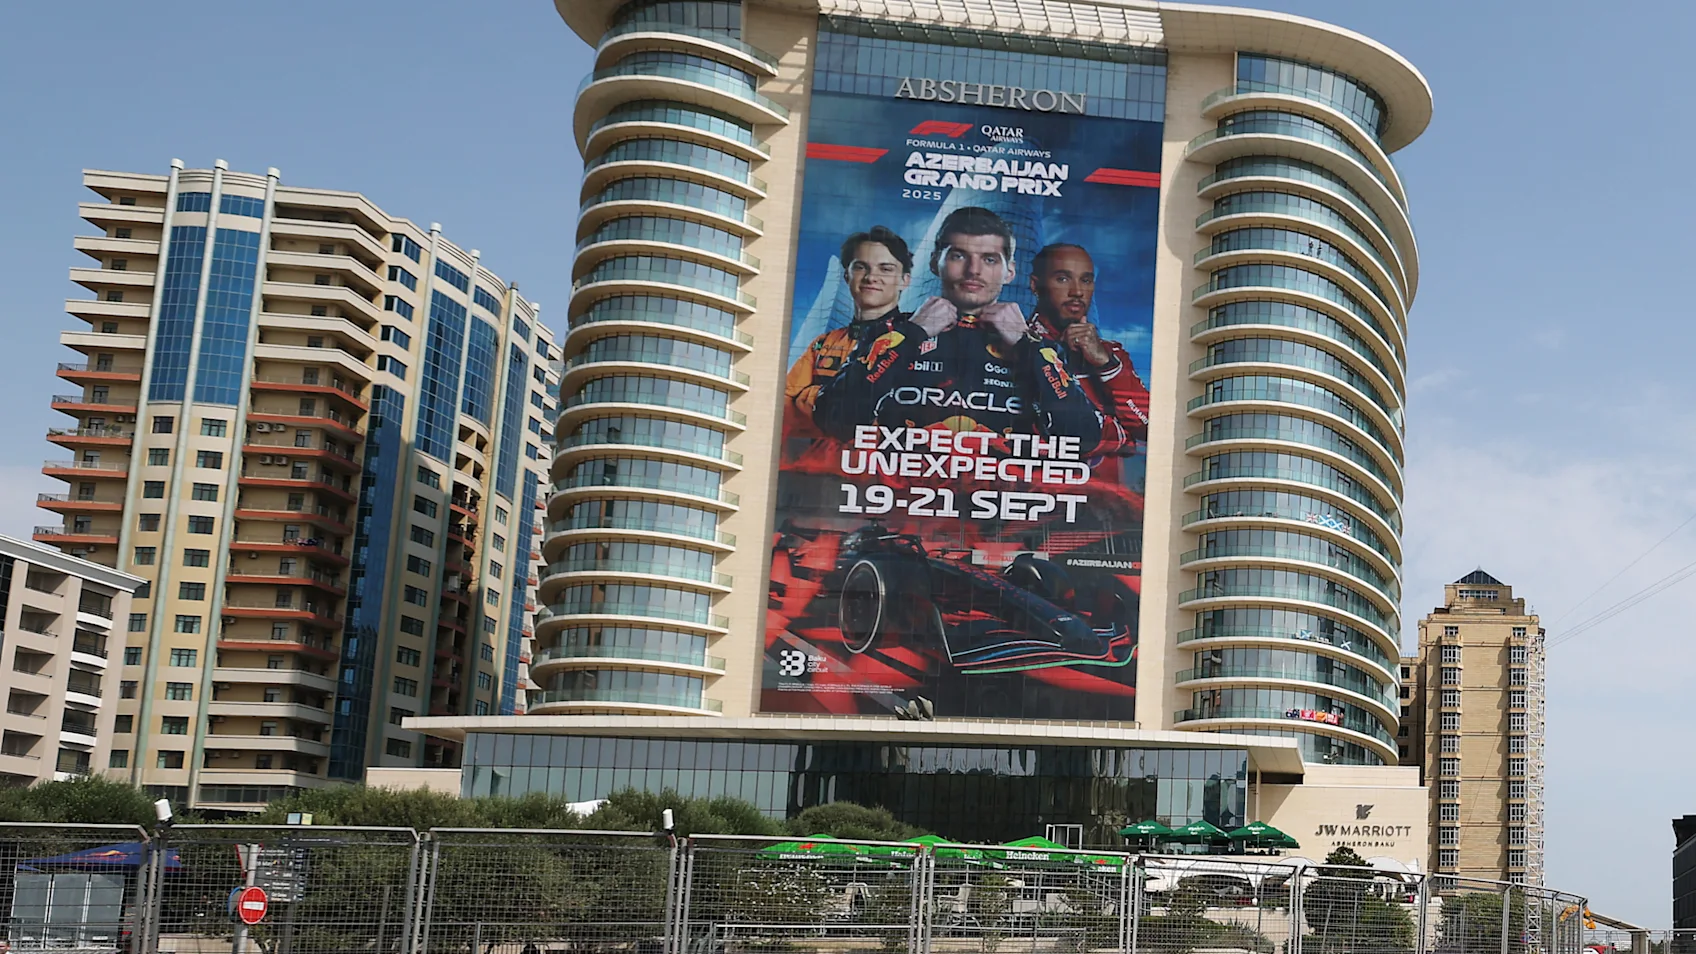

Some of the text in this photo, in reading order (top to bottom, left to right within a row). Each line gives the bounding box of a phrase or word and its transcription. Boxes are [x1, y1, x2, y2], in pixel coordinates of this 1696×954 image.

[894, 76, 1086, 114] ABSHERON
[981, 125, 1024, 138] QATAR
[991, 136, 1024, 144] AIRWAYS
[906, 139, 1051, 158] FORMULA 1 QATAR AIRWAYS
[905, 151, 1069, 180] AZERBAIJAN
[902, 189, 942, 200] 2025
[904, 168, 1063, 197] GRAND PRIX
[894, 386, 1023, 414] ORACLE
[854, 424, 1081, 460] EXPECT THE
[841, 450, 1091, 485] UNEXPECTED
[838, 483, 1088, 523] 19-21 SEPT
[1315, 825, 1411, 837] JW MARRIOTT
[1006, 850, 1050, 861] Heineken
